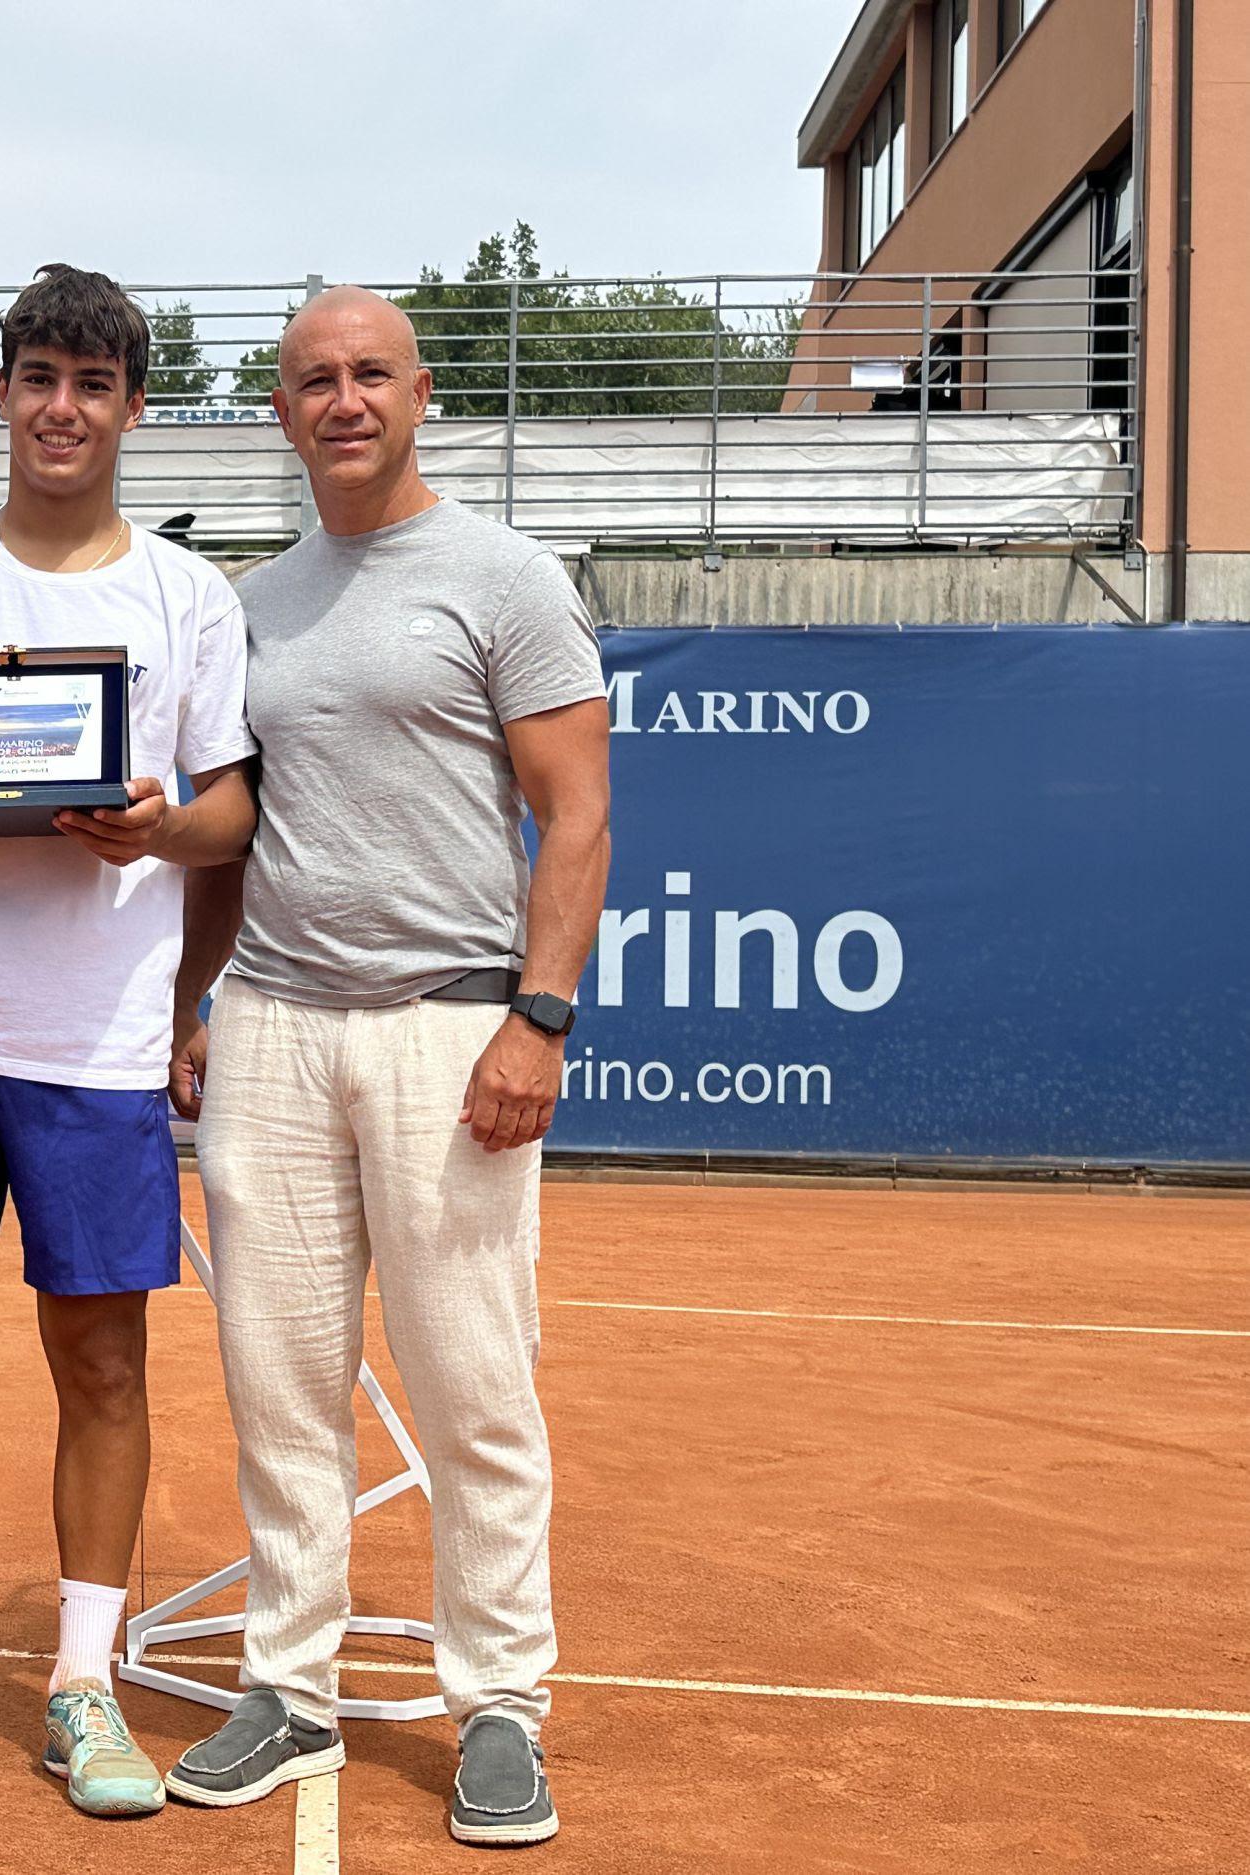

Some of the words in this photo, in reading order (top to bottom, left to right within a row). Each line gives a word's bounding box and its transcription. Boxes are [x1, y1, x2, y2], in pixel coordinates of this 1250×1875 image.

[0, 739, 44, 749] MARINO
[16, 746, 44, 756] OPEN
[571, 872, 903, 1012] rino
